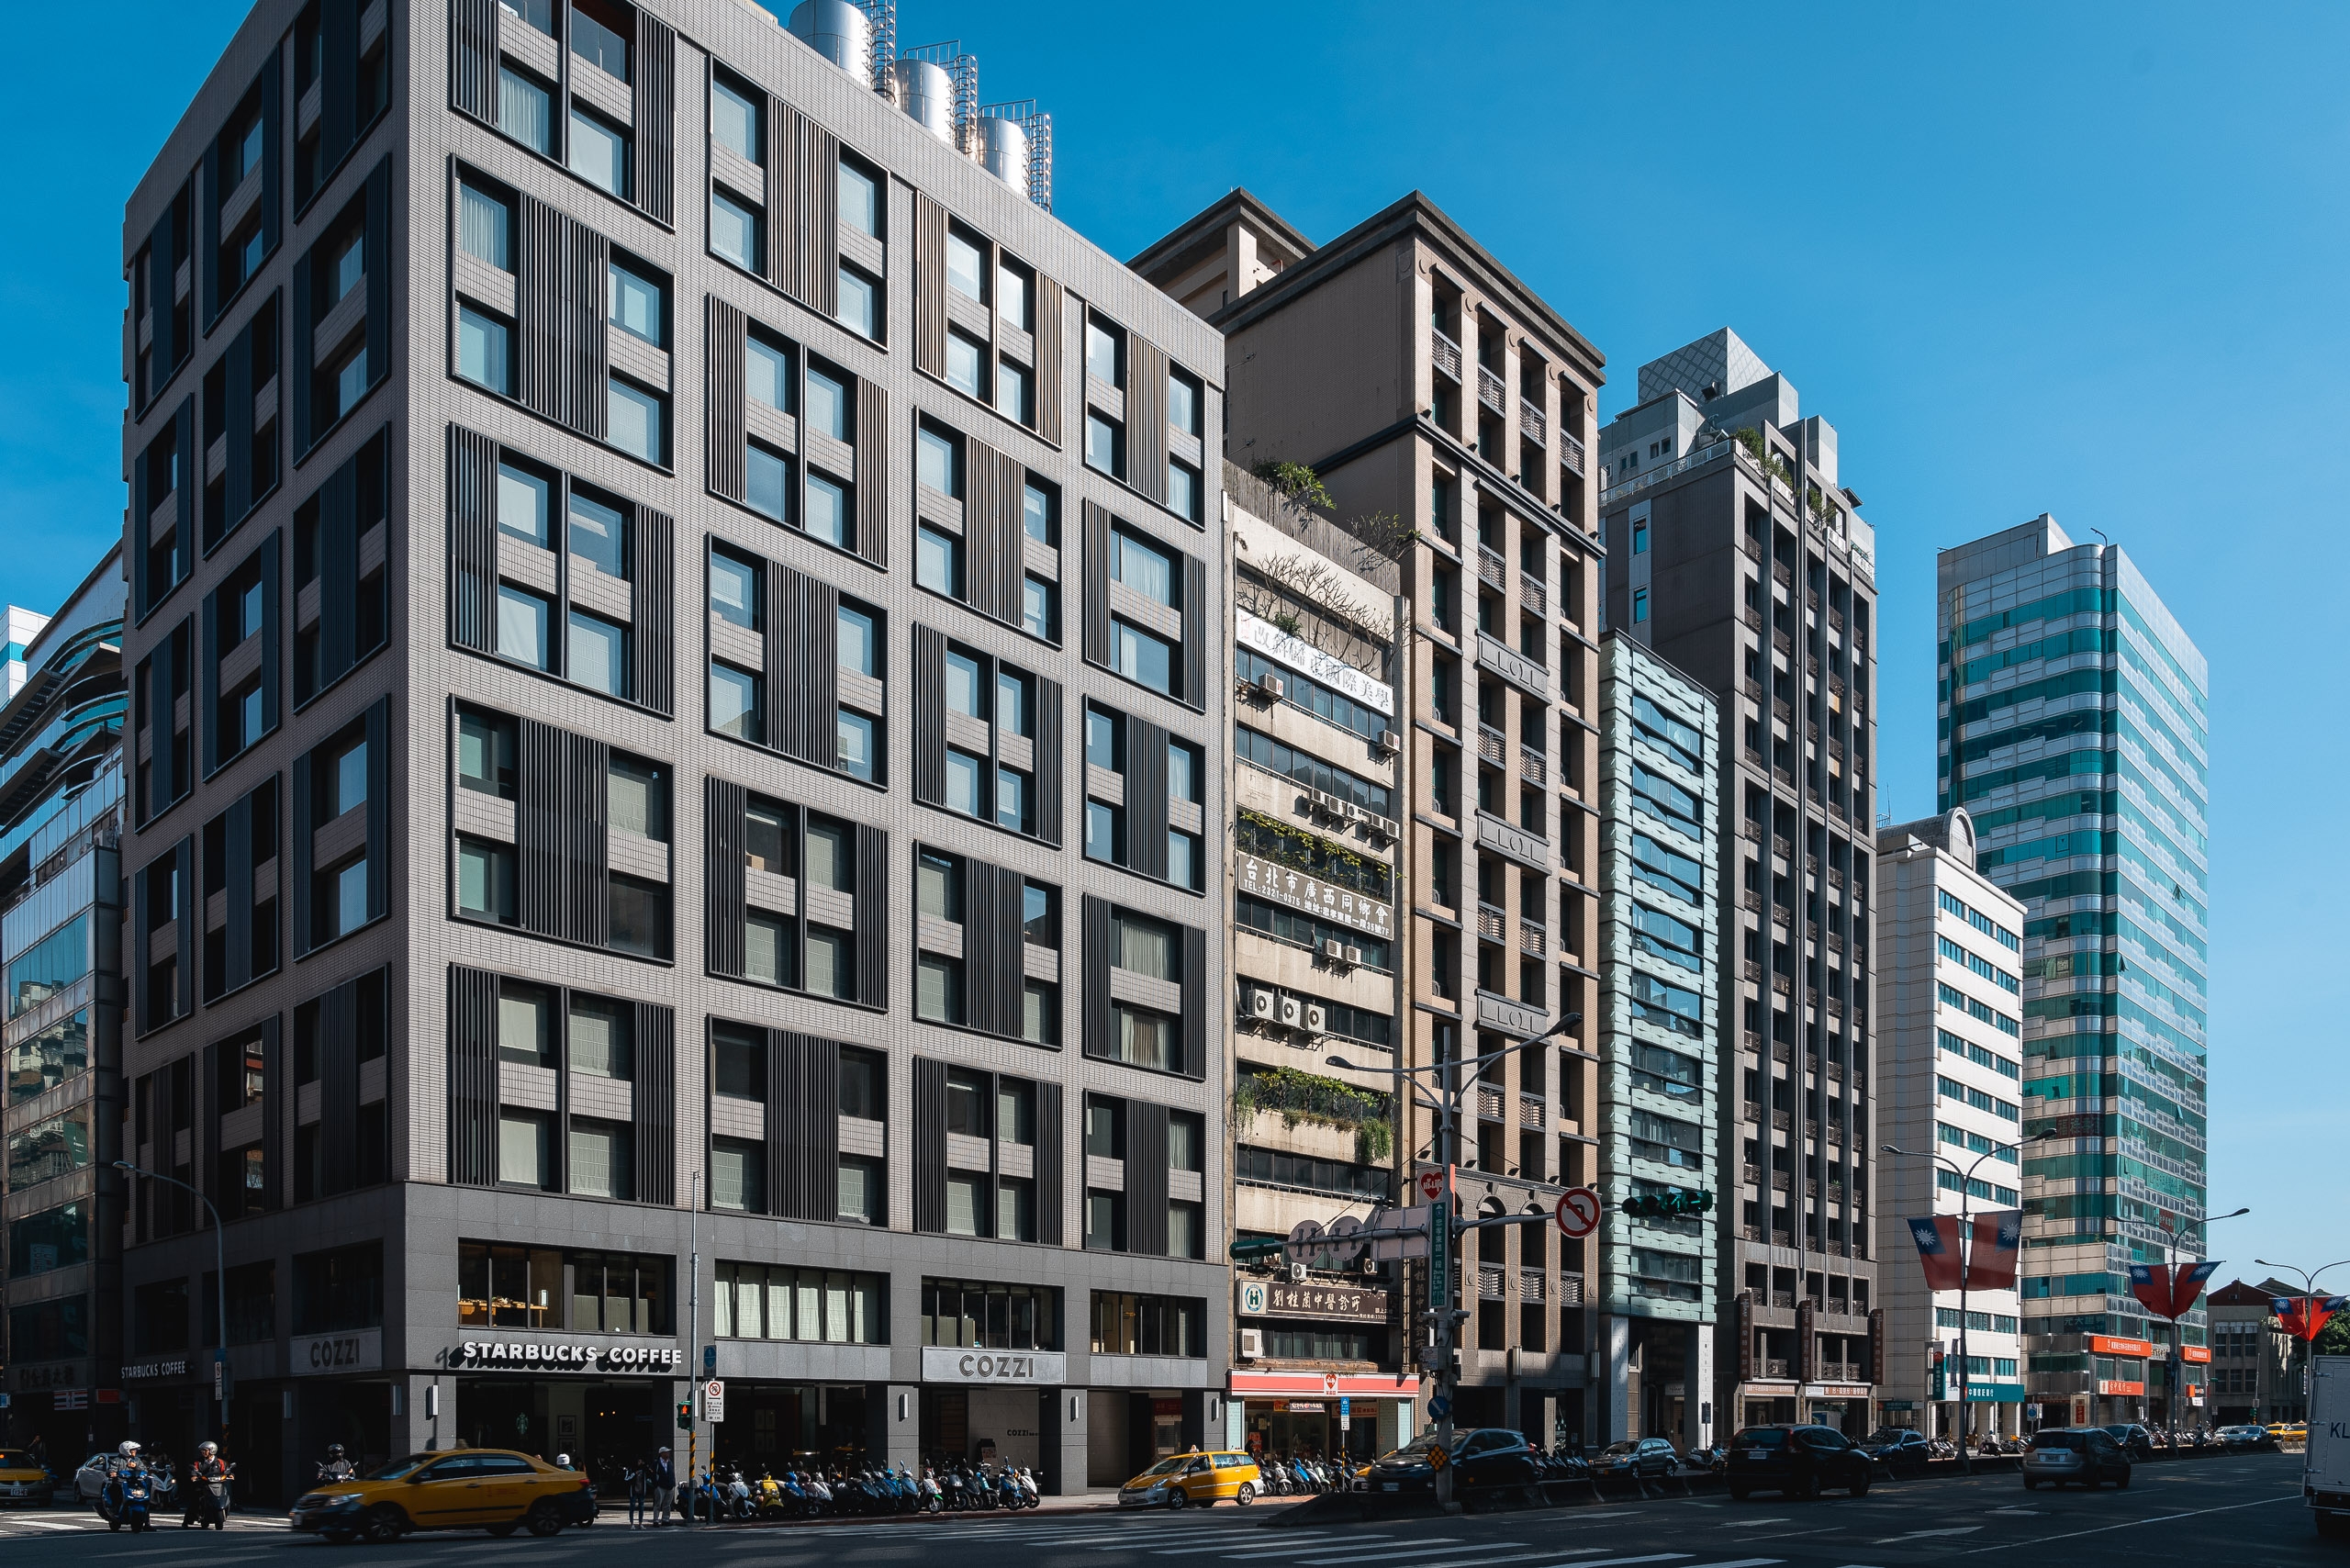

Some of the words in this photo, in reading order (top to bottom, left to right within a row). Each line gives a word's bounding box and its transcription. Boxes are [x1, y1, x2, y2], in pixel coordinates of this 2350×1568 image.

[1243, 879, 1301, 906] TEL:2321-0375
[1245, 858, 1389, 925] 台北市廣西同鄉會
[1272, 1288, 1361, 1313] 劉桂蘭中醫診所
[309, 1338, 361, 1368] COZZI
[464, 1341, 598, 1362] STARBUCKS
[610, 1347, 682, 1364] COFFEE
[121, 1364, 158, 1379] STARBUCKS
[161, 1361, 185, 1376] COFFEE
[958, 1354, 1034, 1378] COZZI
